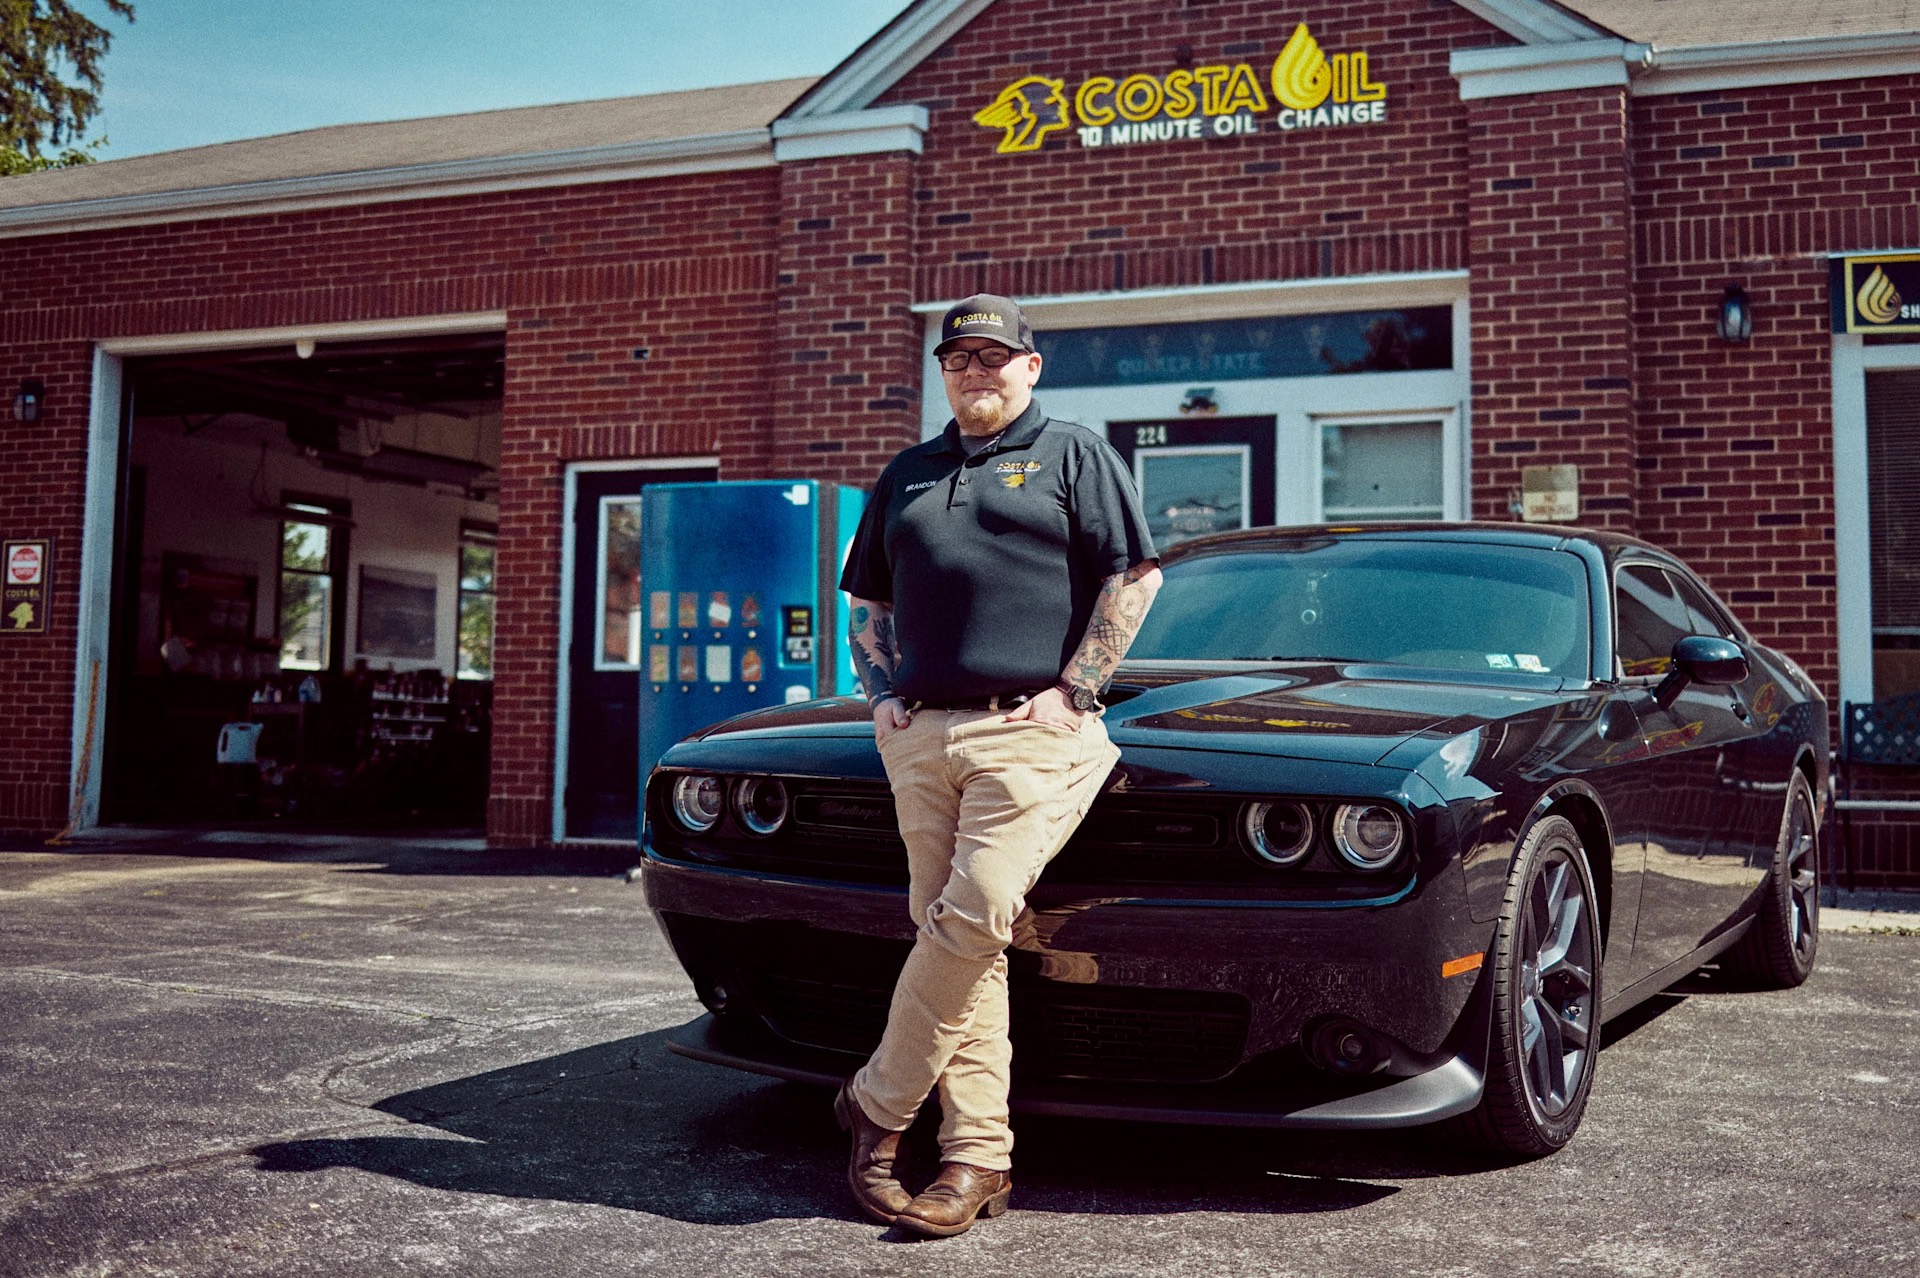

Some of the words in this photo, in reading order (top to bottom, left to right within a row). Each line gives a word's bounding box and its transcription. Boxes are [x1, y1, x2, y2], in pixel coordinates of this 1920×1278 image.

[1075, 63, 1268, 126] COSTA
[1271, 22, 1388, 110] OIL
[1077, 126, 1102, 148] 10
[1111, 118, 1203, 145] MINUTE
[1213, 114, 1259, 136] OIL
[1277, 102, 1387, 130] CHANGE
[962, 313, 989, 323] COSTA
[1136, 425, 1167, 445] 224
[905, 481, 937, 492] BRANDON
